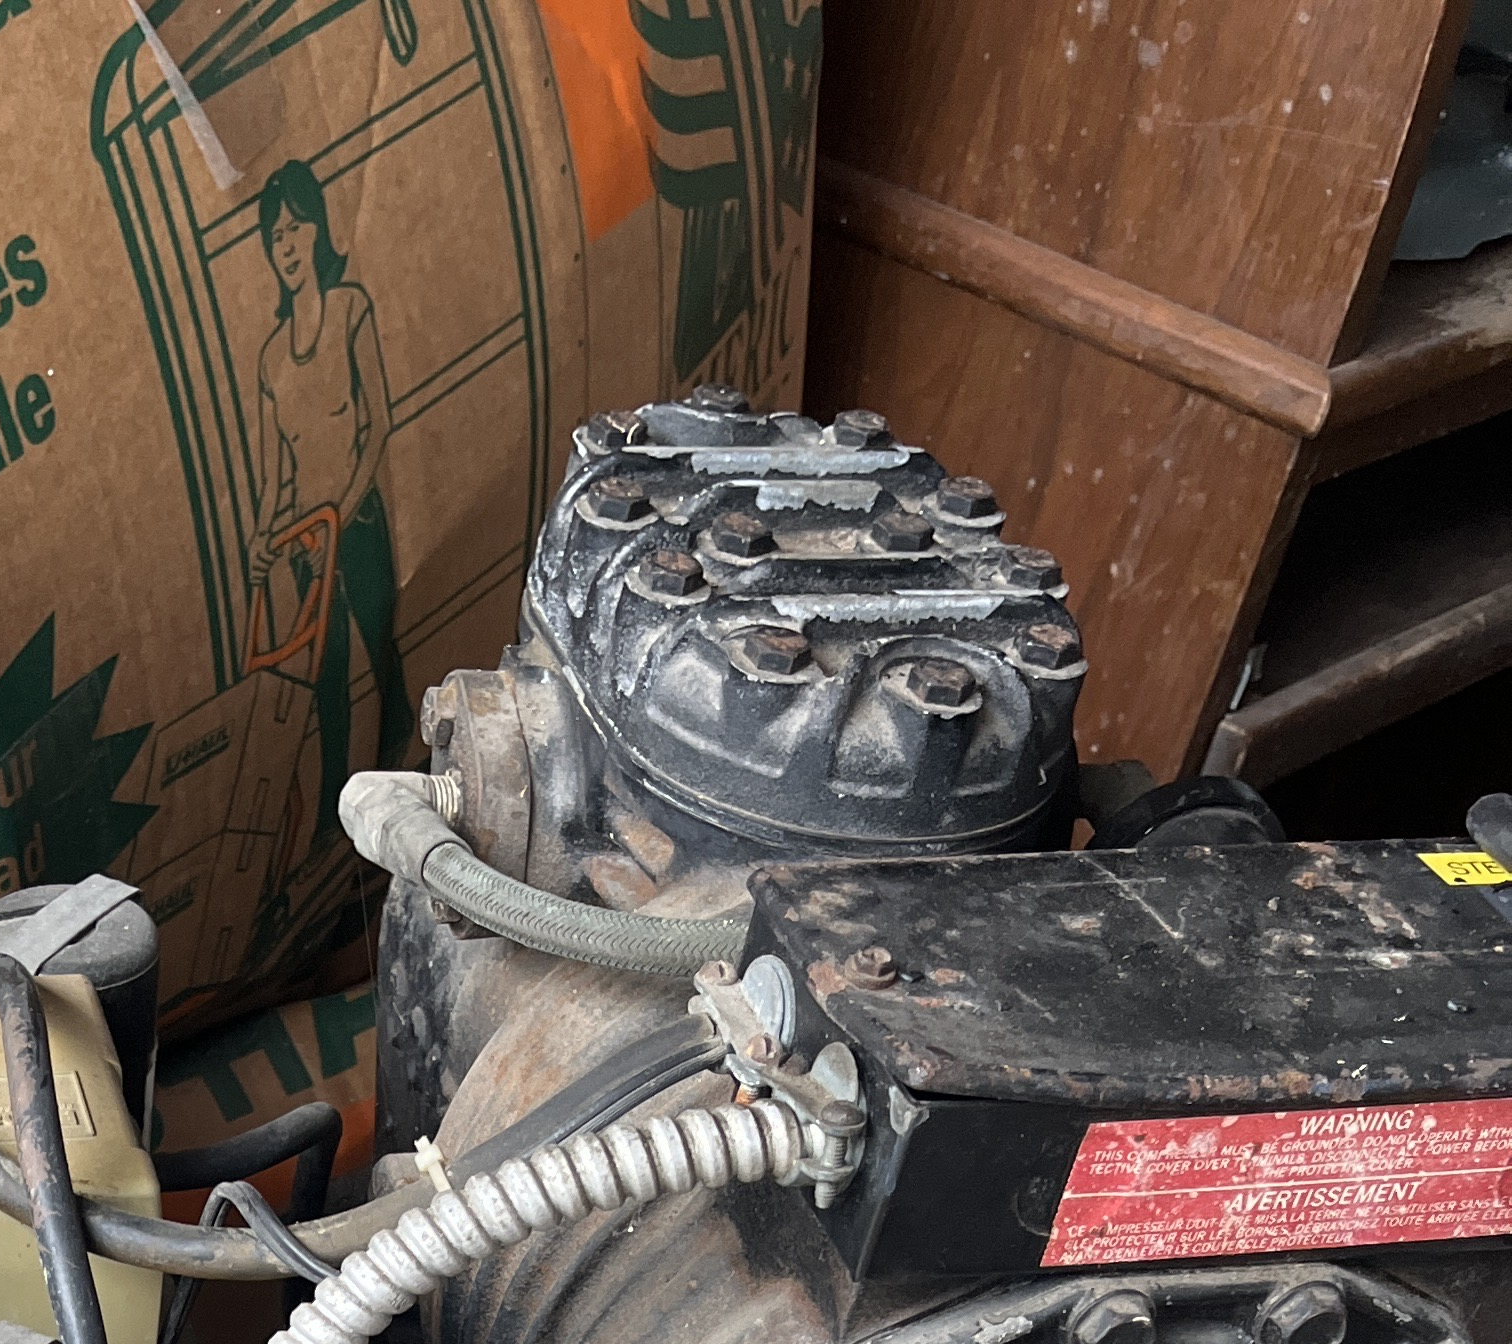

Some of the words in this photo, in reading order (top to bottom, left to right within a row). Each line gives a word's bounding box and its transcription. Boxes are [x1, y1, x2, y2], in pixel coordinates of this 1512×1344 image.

[1447, 861, 1505, 875] STE
[1299, 1109, 1416, 1136] WARNING
[1089, 1162, 1141, 1176] TECTIVE
[1146, 1159, 1191, 1174] COVER
[1193, 1158, 1229, 1172] OVER
[1311, 1147, 1394, 1164] DISCONNECT
[1421, 1142, 1472, 1156] POWER
[1093, 1150, 1124, 1161] THIS
[1261, 1141, 1280, 1153] BE
[1362, 1135, 1384, 1148] DO
[1384, 1132, 1415, 1147] NOT
[1417, 1129, 1474, 1144] OPERATE
[1261, 1165, 1288, 1179] THE
[1227, 1181, 1424, 1214] AVERTISSEMENT
[1067, 1225, 1087, 1238] CE
[1089, 1218, 1184, 1236] CMPRESSEUR
[1255, 1213, 1277, 1225] MIS
[1289, 1211, 1306, 1223] LA
[1375, 1205, 1399, 1216] PAS
[1459, 1198, 1491, 1210] SANS
[1092, 1232, 1178, 1250] PROTECTEUR
[1179, 1231, 1207, 1243] SUR
[1384, 1214, 1425, 1228] TOUTE
[1174, 1242, 1190, 1255] LE
[1191, 1237, 1270, 1254] COUVERCLE
[1270, 1232, 1354, 1249] PROTECTEUR
